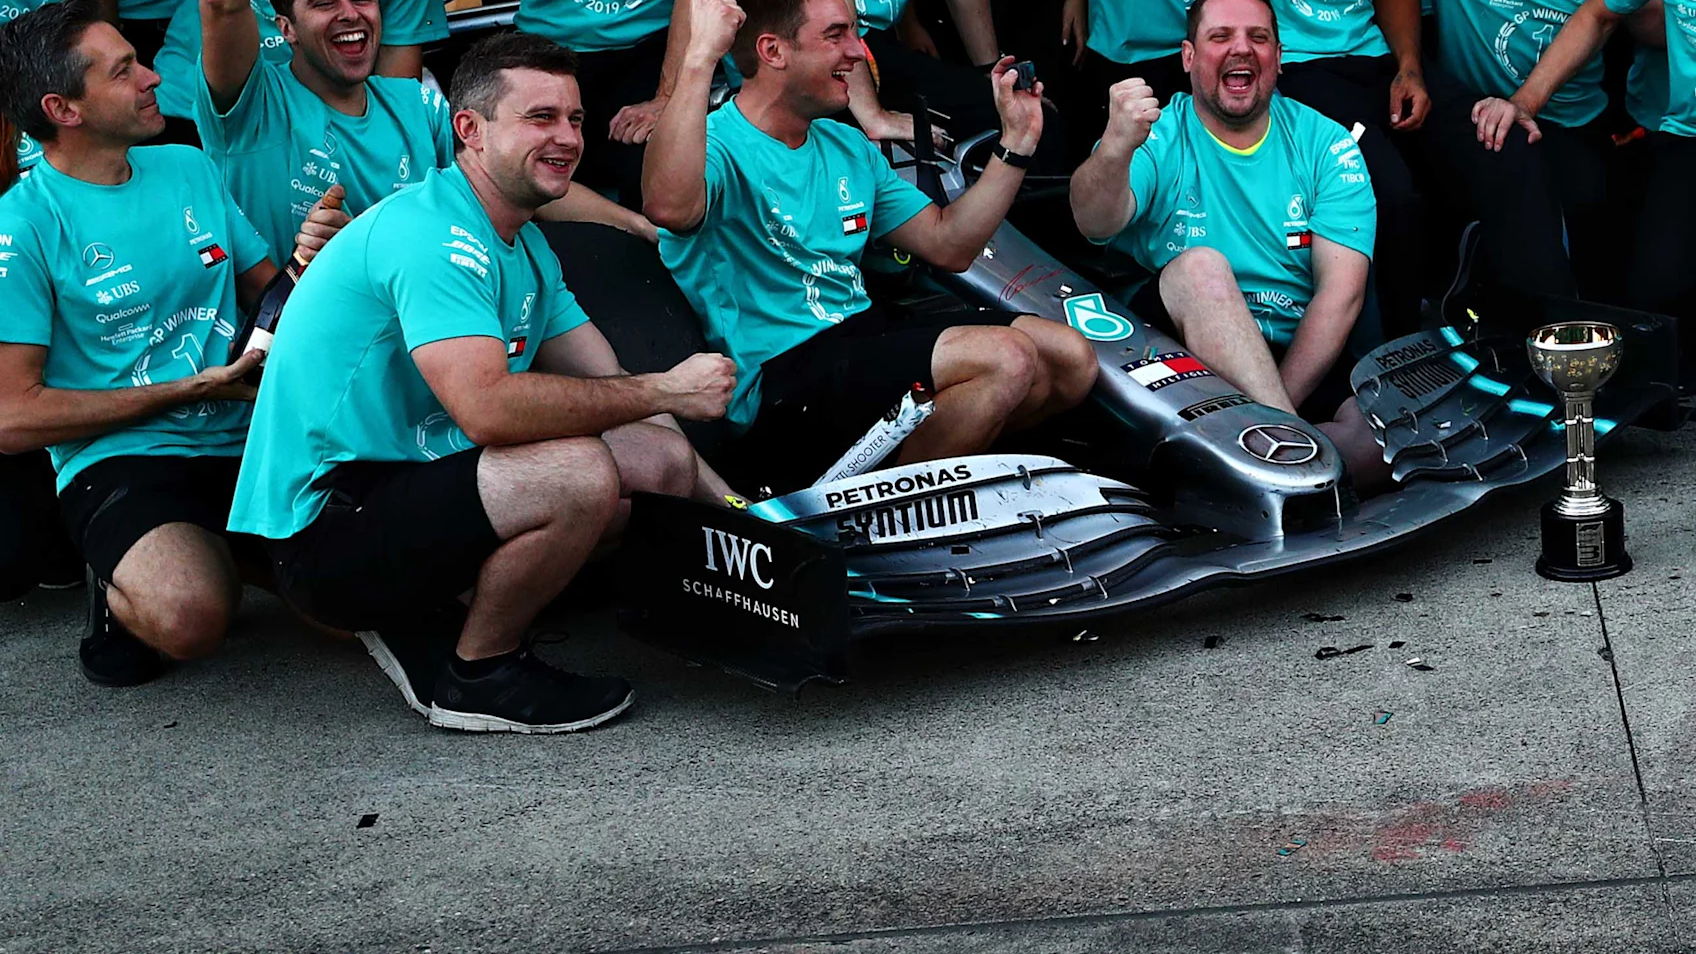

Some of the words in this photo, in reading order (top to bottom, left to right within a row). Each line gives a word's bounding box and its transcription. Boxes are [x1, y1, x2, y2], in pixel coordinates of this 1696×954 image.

[0, 5, 31, 20] 20
[1514, 10, 1530, 24] GP
[1532, 8, 1568, 23] WINN
[291, 178, 325, 198] Qualco
[111, 280, 141, 299] UBS
[1247, 290, 1294, 310] WINNER
[96, 303, 151, 323] Qualcomm
[163, 306, 218, 332] WINNER
[1127, 352, 1186, 370] TOMMY
[1376, 340, 1437, 370] PETRONAS
[825, 464, 973, 509] PETRONAS
[837, 489, 979, 539] SYNTIUM
[702, 526, 775, 590] IWC
[682, 577, 800, 629] SCHAFFHAUSEN
